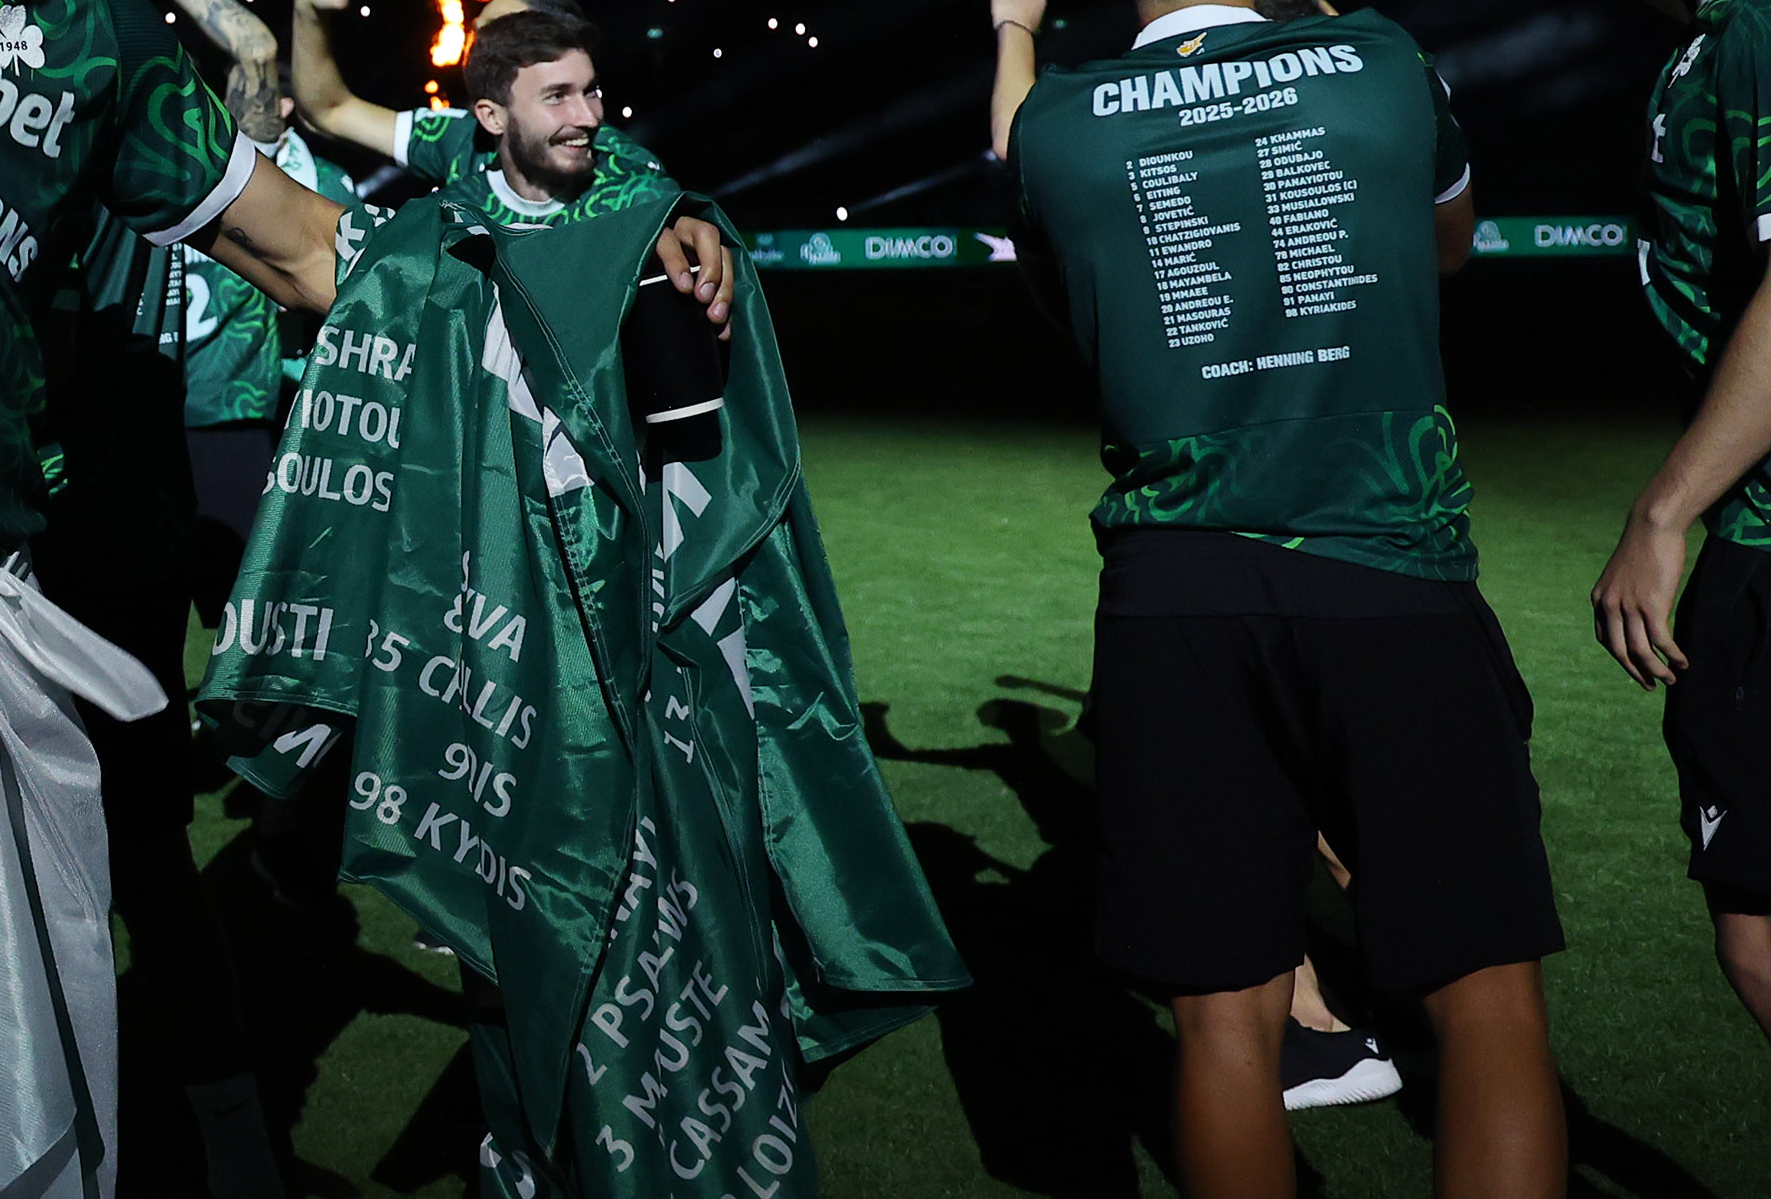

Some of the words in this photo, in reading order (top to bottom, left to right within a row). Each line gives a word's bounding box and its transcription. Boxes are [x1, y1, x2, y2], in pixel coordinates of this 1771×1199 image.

[0, 40, 28, 52] 1948
[1091, 44, 1364, 118] CHAMPIONS
[1178, 87, 1299, 127] 2025-2026
[1255, 137, 1268, 147] 24
[1270, 127, 1326, 144] KHAMMAS
[1257, 148, 1270, 158] 27
[1271, 140, 1303, 155] SIMIĆ
[1126, 161, 1133, 169] 2
[1139, 150, 1193, 167] DIOUNKOU
[1259, 159, 1273, 169] 28
[1274, 150, 1324, 166] ODUBAJO
[1128, 172, 1135, 180] 3
[1140, 164, 1177, 178] KITSOS
[1261, 170, 1274, 180] 29
[1276, 161, 1331, 178] BALKOVEC
[1131, 182, 1138, 191] 5
[1142, 171, 1198, 189] COULIBALY
[1263, 182, 1277, 191] 30
[1278, 170, 1343, 189] PANAYIOTOU
[1134, 194, 1141, 202] 6
[1146, 186, 1181, 200] EITING
[1265, 193, 1277, 203] 31
[1280, 183, 1342, 200] KOUSOULOS
[1137, 205, 1143, 213] 7
[1149, 196, 1192, 211] SEMEDO
[1267, 205, 1280, 214] 33
[1282, 193, 1355, 212] MUSIALOWSKI
[1140, 215, 1147, 223] 8
[1153, 205, 1195, 222] JOVETIĆ
[1269, 216, 1282, 225] 40
[1283, 209, 1329, 224] FABIANO
[1143, 226, 1150, 235] 9
[1155, 216, 1209, 233] STEPINSKI
[1147, 237, 1158, 246] 10
[1159, 222, 1241, 244] CHATZIGIOVANIS
[1271, 228, 1284, 236] 44
[1285, 218, 1338, 235] ERAKOVIĆ
[1273, 239, 1286, 249] 74
[1288, 232, 1337, 247] ANDREOU
[1534, 224, 1624, 247] DIMCO
[865, 235, 954, 260] DIMCO
[1149, 249, 1160, 257] 11
[1161, 239, 1213, 255] EWANDRO
[1275, 251, 1288, 260] 78
[1289, 244, 1336, 258] MICHAEL
[1152, 260, 1163, 268] 14
[1164, 252, 1197, 267] MARIĆ
[1277, 262, 1291, 272] 82
[1292, 255, 1343, 270] CHRISTOU
[1154, 270, 1166, 279] 17
[1167, 262, 1220, 278] AGOUZOUL
[1280, 274, 1292, 283] 85
[1293, 265, 1355, 281] NEOPHYTOU
[1157, 281, 1168, 291] 18
[1169, 272, 1233, 289] MAYAMBELA
[1281, 285, 1294, 294] 90
[1159, 293, 1171, 302] 19
[1172, 287, 1209, 300] MMAEE
[1283, 297, 1295, 306] 91
[1298, 291, 1335, 304] PANAYI
[1161, 305, 1174, 314] 20
[1175, 296, 1222, 312] ANDREOU
[1285, 308, 1298, 318] 98
[1300, 300, 1357, 316] KYRIAKIDES
[1163, 316, 1175, 325] 21
[1177, 307, 1231, 323] MASOURAS
[1166, 327, 1179, 336] 22
[1179, 317, 1229, 335] TANKOVIĆ
[1168, 338, 1181, 348] 23
[1181, 333, 1215, 346] UZOHO
[1201, 359, 1254, 380] COACH:
[1255, 348, 1314, 373] HENNING
[1317, 346, 1351, 364] BERG
[349, 771, 408, 826] 98
[736, 1057, 798, 1199] LOIZ
[595, 1124, 635, 1173] 3
